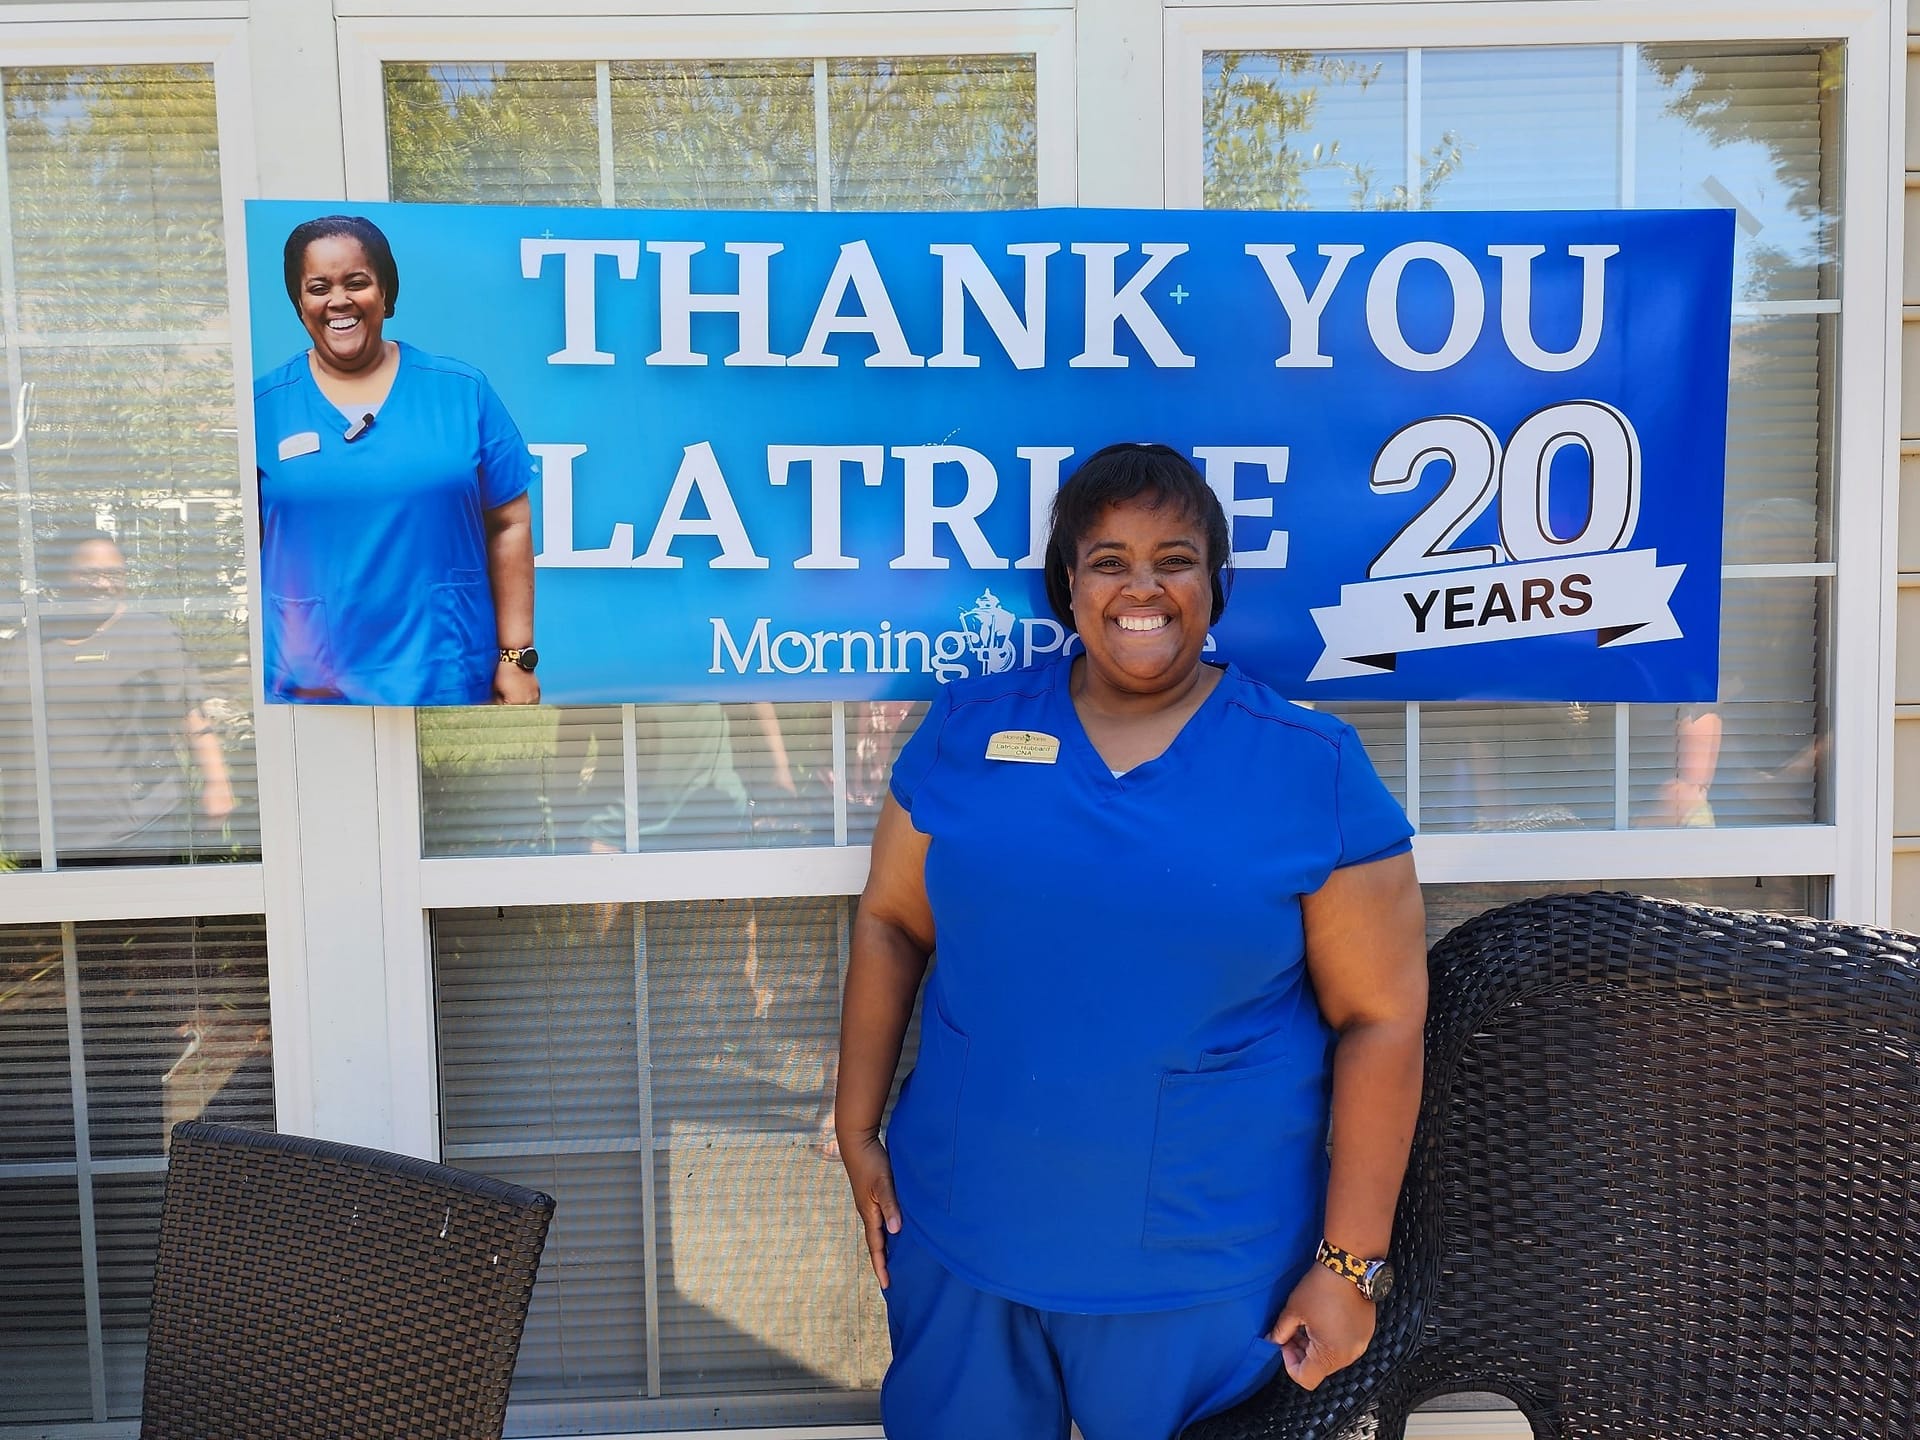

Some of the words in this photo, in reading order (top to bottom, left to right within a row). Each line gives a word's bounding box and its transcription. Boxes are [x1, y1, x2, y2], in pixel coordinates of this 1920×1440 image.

[520, 239, 1196, 369] THANK
[1245, 241, 1620, 372] YOU
[528, 441, 1289, 570] LATRIE
[1366, 399, 1642, 580] 20
[708, 617, 981, 684] Morning
[1403, 573, 1594, 633] YEARS
